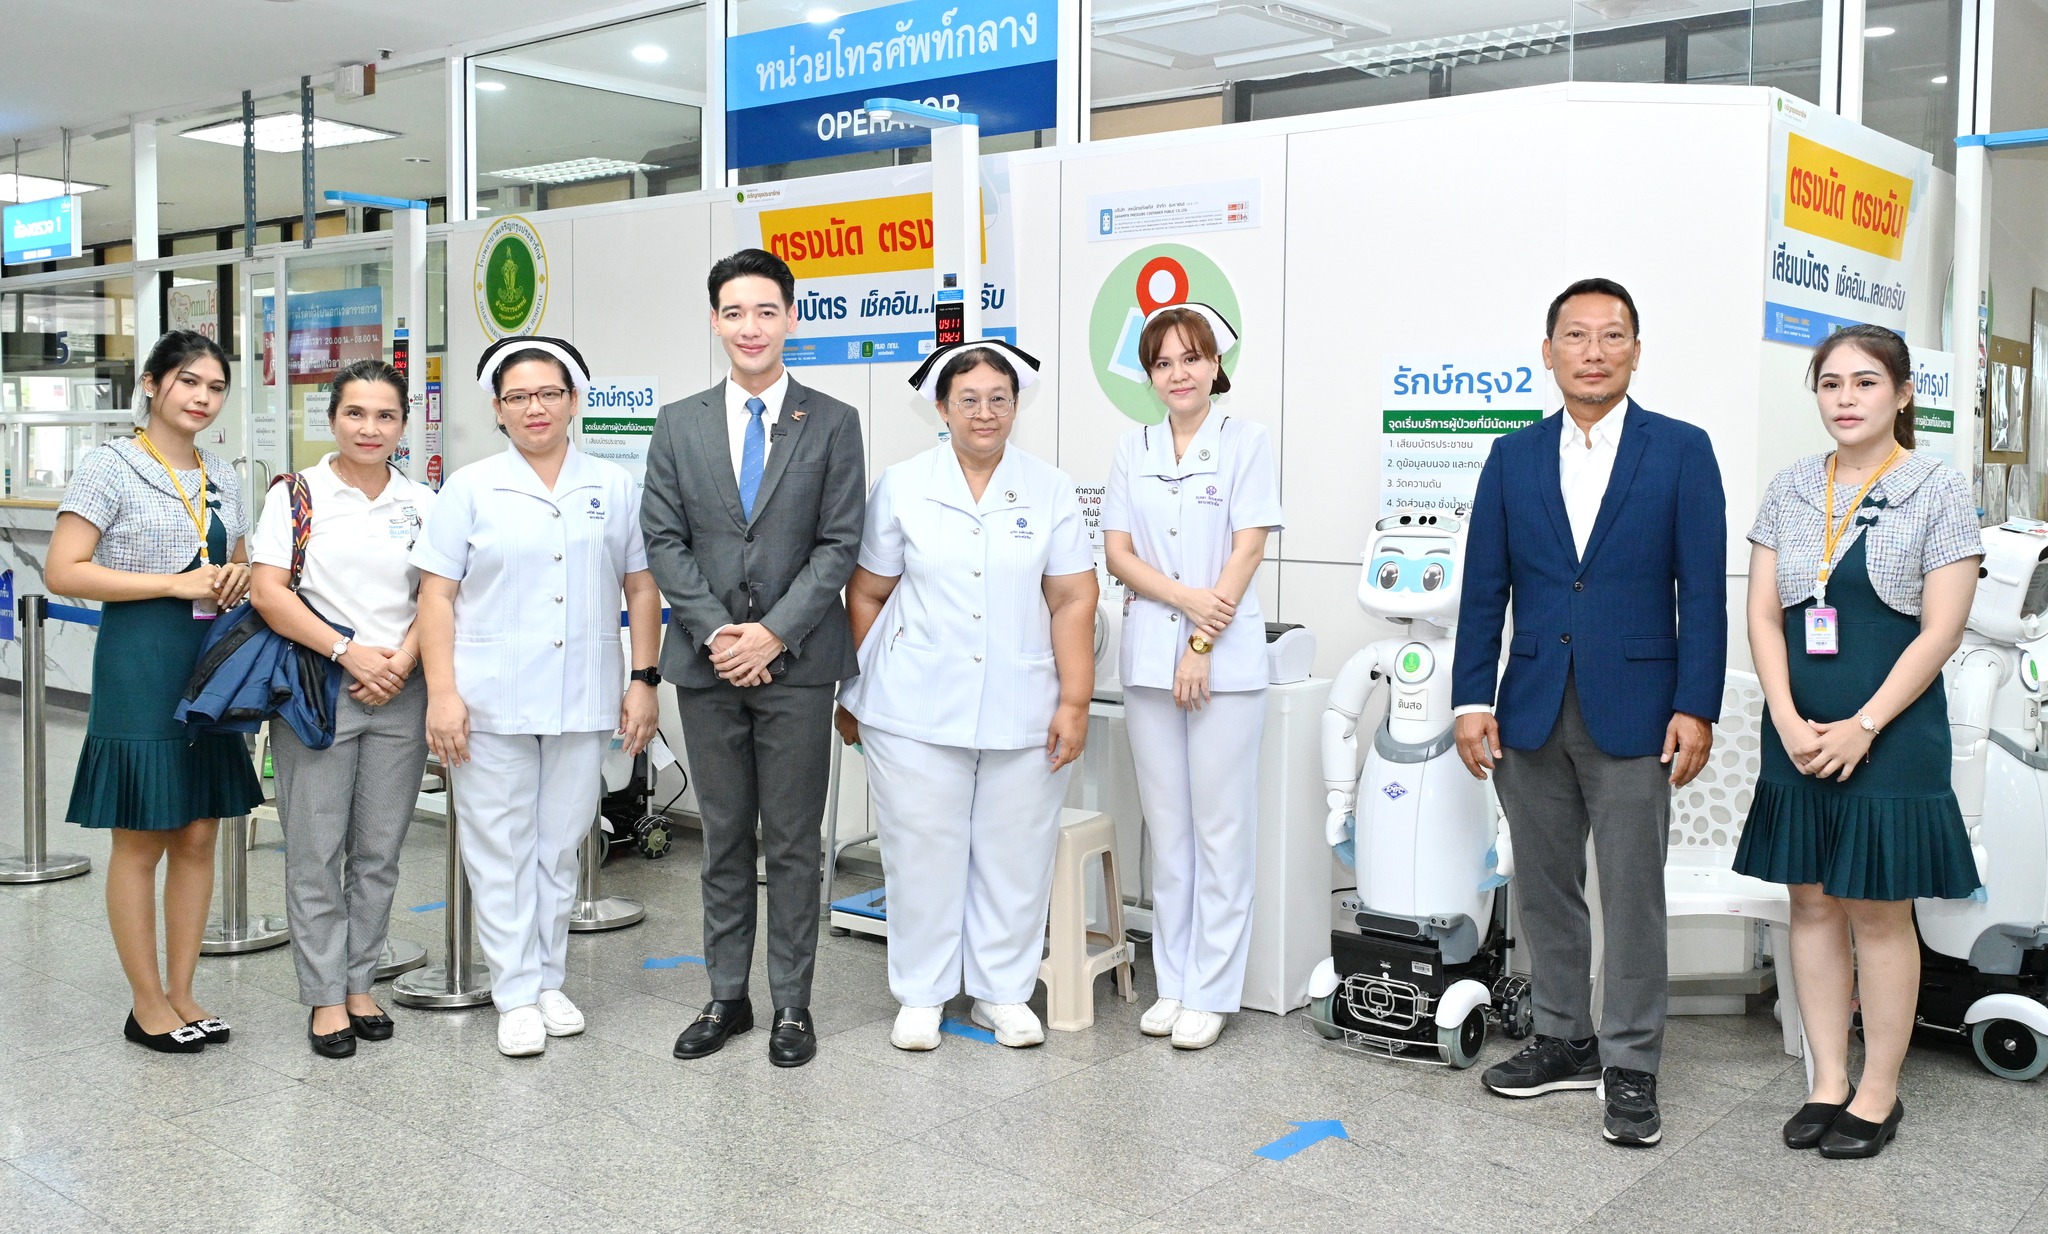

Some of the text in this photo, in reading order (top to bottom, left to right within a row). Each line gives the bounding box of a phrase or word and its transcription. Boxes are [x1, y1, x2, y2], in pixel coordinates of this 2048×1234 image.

[755, 7, 1038, 92] หน่วยโทรศัพท์กลาง
[1790, 166, 1904, 239] ตรงนัด ตรงวัน
[771, 217, 864, 262] ตรงนัด
[1772, 242, 1830, 293] เสียบบัตร
[55, 330, 68, 365] 5
[1393, 364, 1532, 403] รักษ์กรุง2
[587, 385, 654, 413] รักษ์กรุง3
[1390, 438, 1473, 449] 1. เสียบบัตรประชาชน
[1387, 459, 1395, 468] 2.
[1396, 459, 1450, 471] ดูข้อมูลบนจอ
[1387, 478, 1442, 489] 3. วัดความดัน
[1089, 496, 1102, 505] 140
[1386, 499, 1394, 507] 4.
[1396, 498, 1436, 510] วัดส่วนสูง
[1398, 698, 1423, 711] ดินสอ
